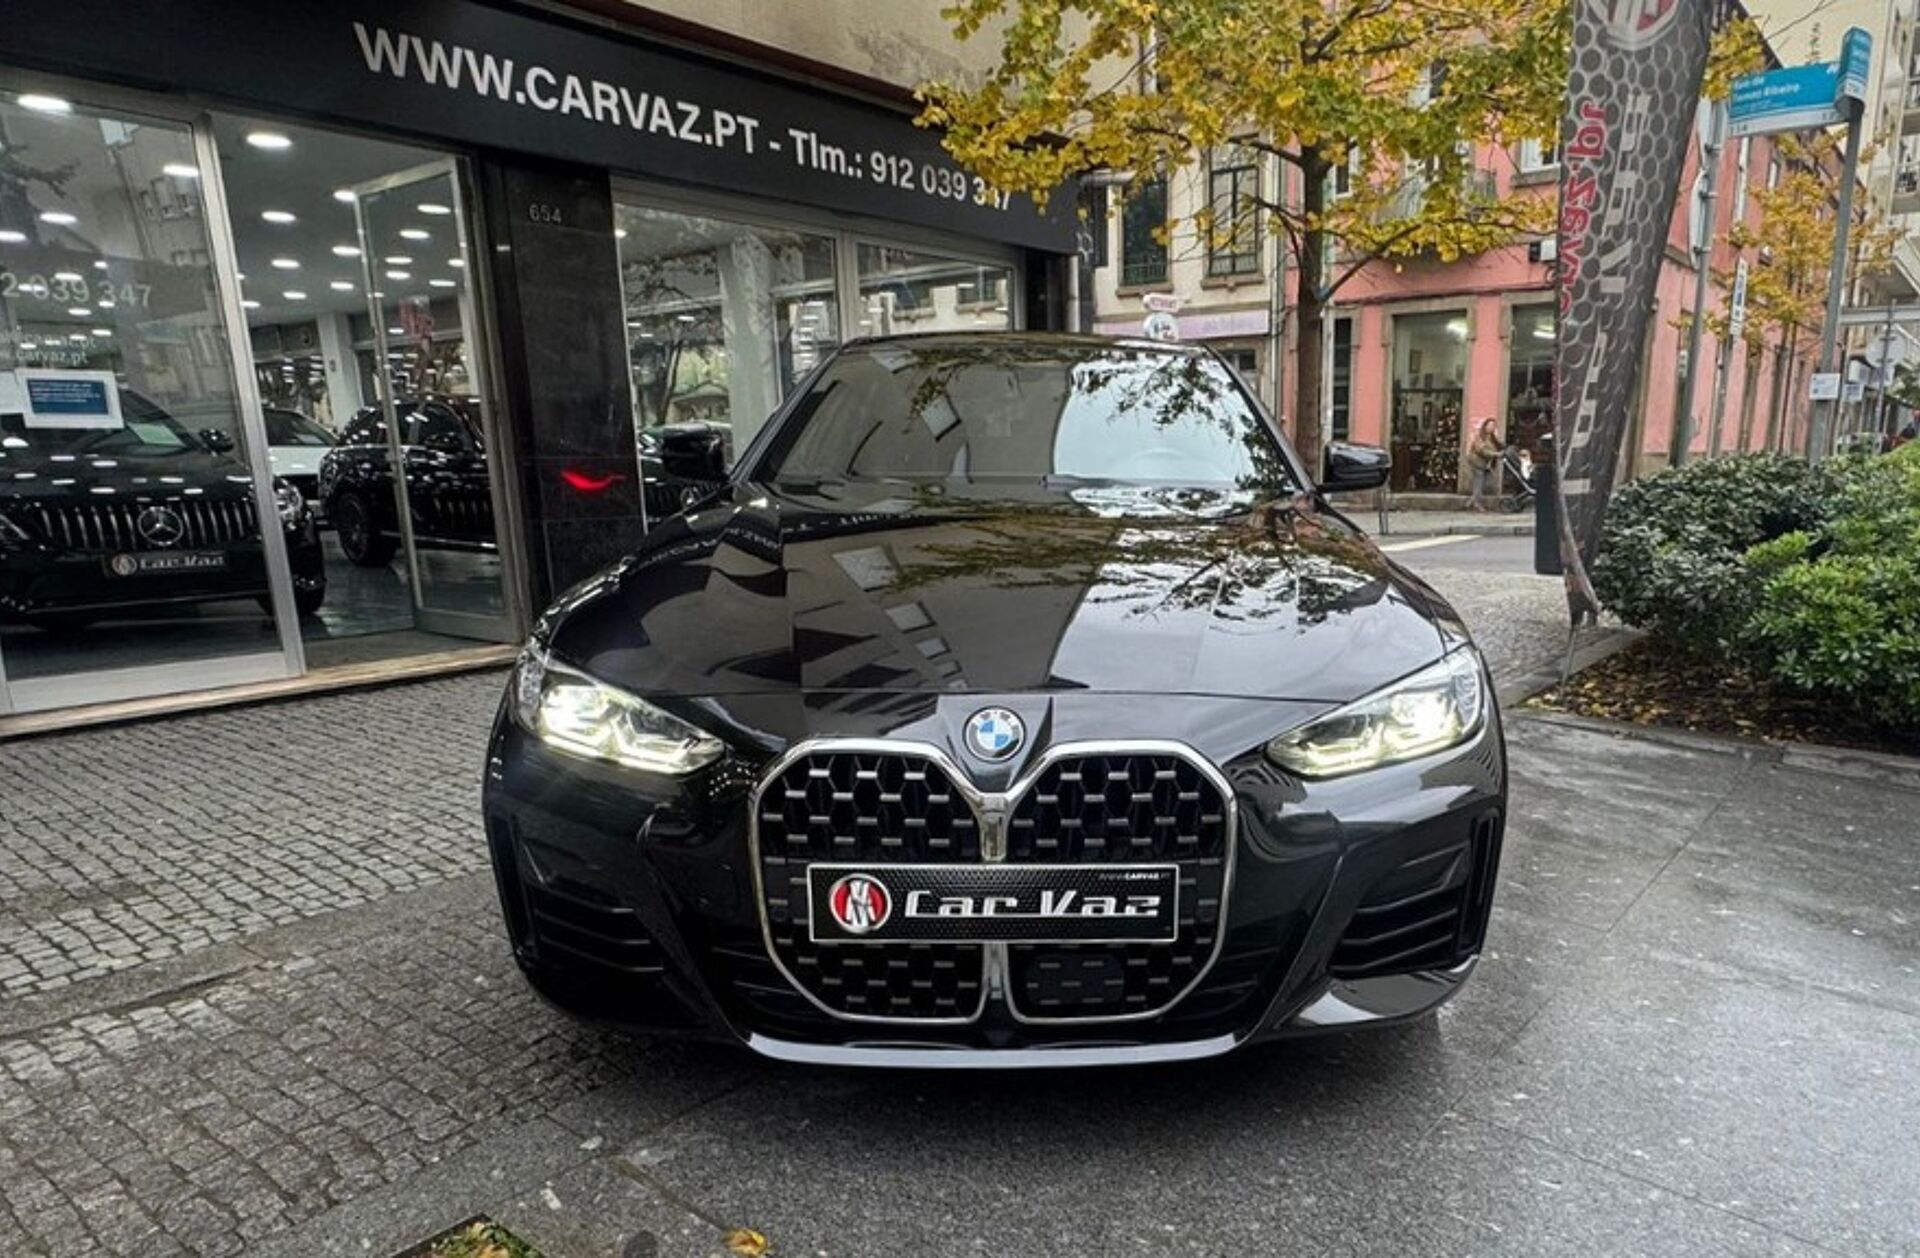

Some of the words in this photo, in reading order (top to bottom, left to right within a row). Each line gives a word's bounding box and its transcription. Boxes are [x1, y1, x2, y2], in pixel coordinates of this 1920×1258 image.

[354, 22, 759, 154] WWW.CARVAZ.PT
[788, 128, 863, 179] Tlm.:
[869, 151, 915, 190] 912
[921, 164, 967, 201] 039
[904, 890, 1018, 918] Car
[1040, 890, 1160, 918] Vaz
